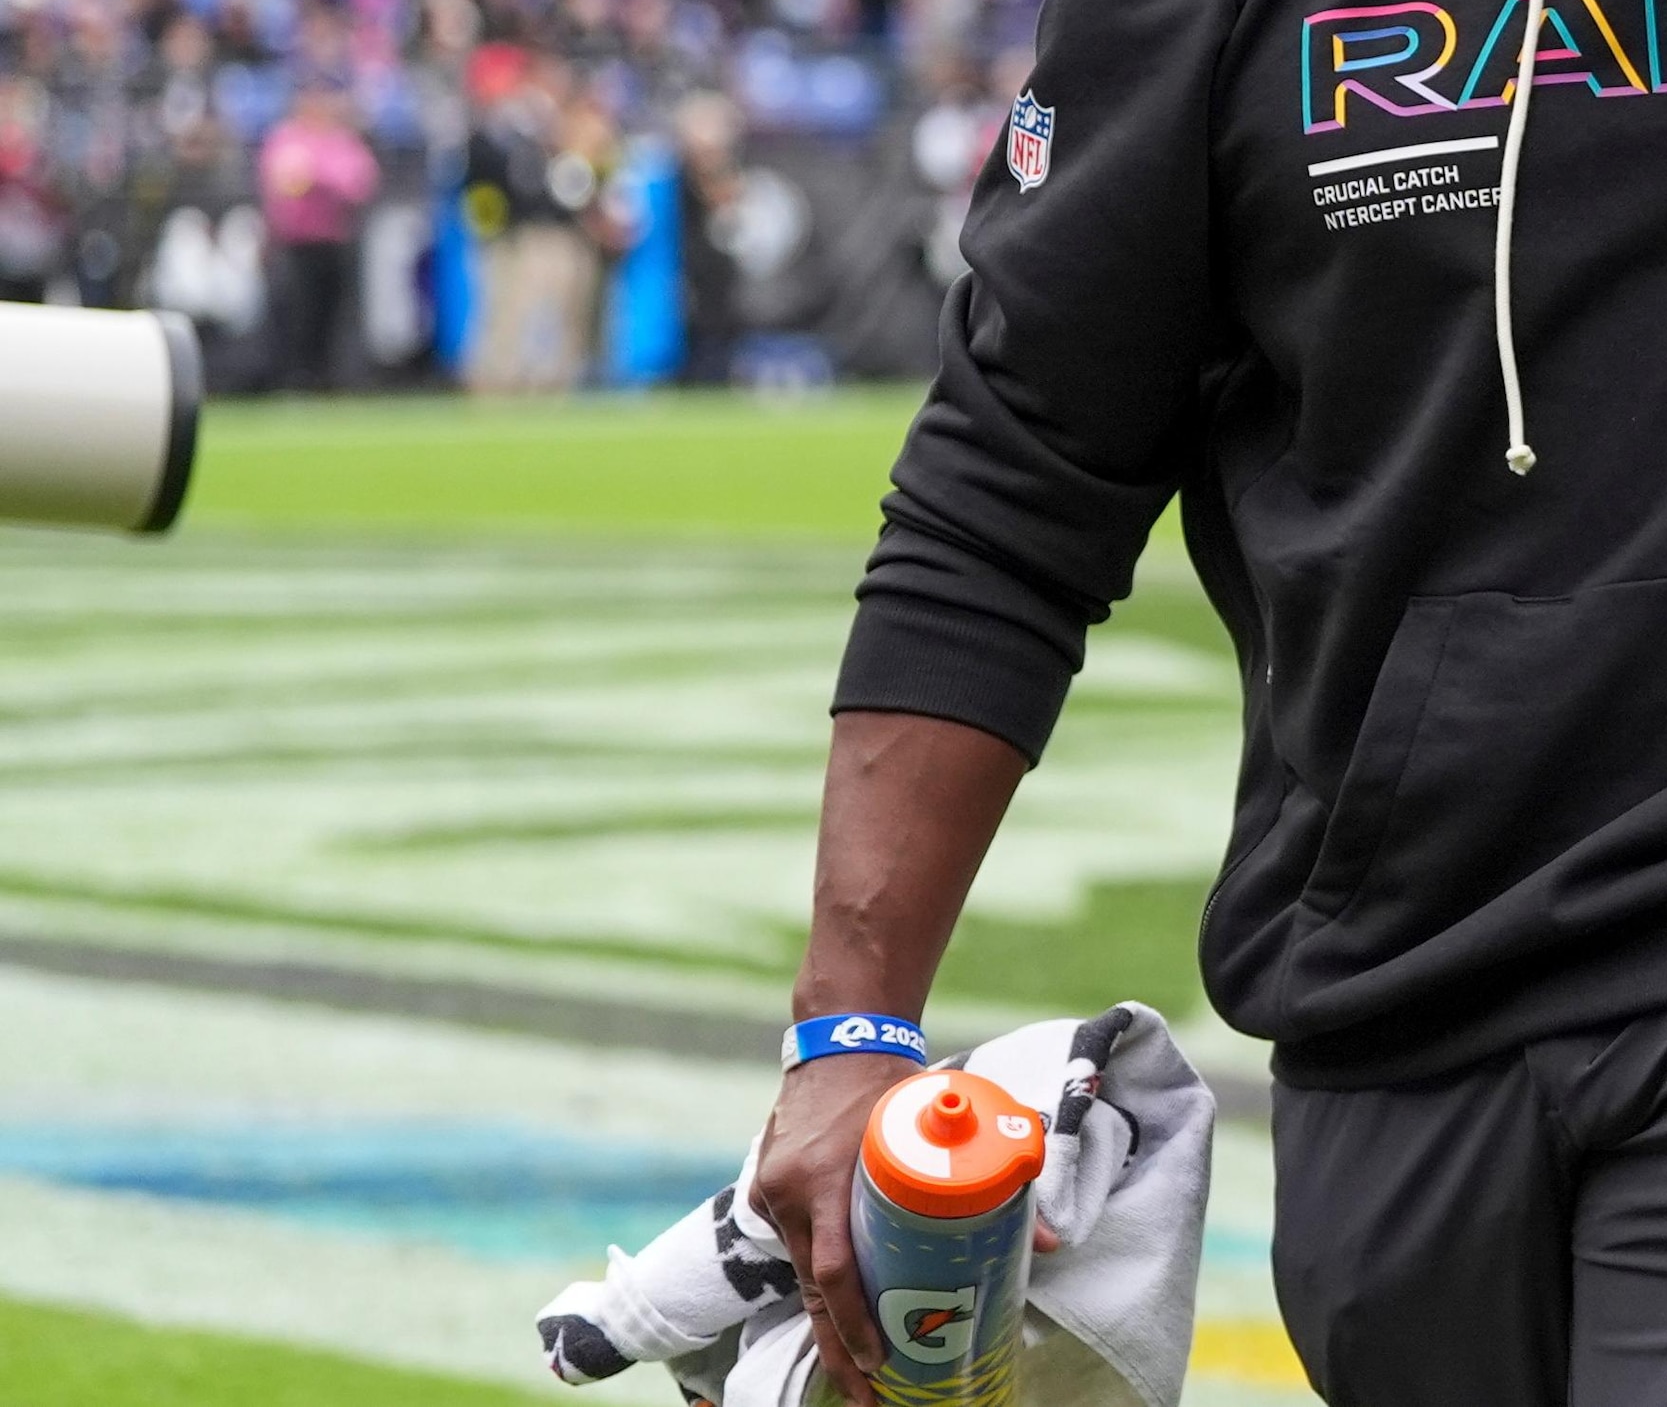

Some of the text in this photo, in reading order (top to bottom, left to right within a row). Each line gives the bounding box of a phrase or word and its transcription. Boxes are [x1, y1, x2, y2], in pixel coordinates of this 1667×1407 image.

[1013, 129, 1043, 176] NFL
[1313, 165, 1460, 206] CRUCIAL CATCH
[1323, 197, 1417, 231] NTERCEPT
[877, 1285, 977, 1365] G
